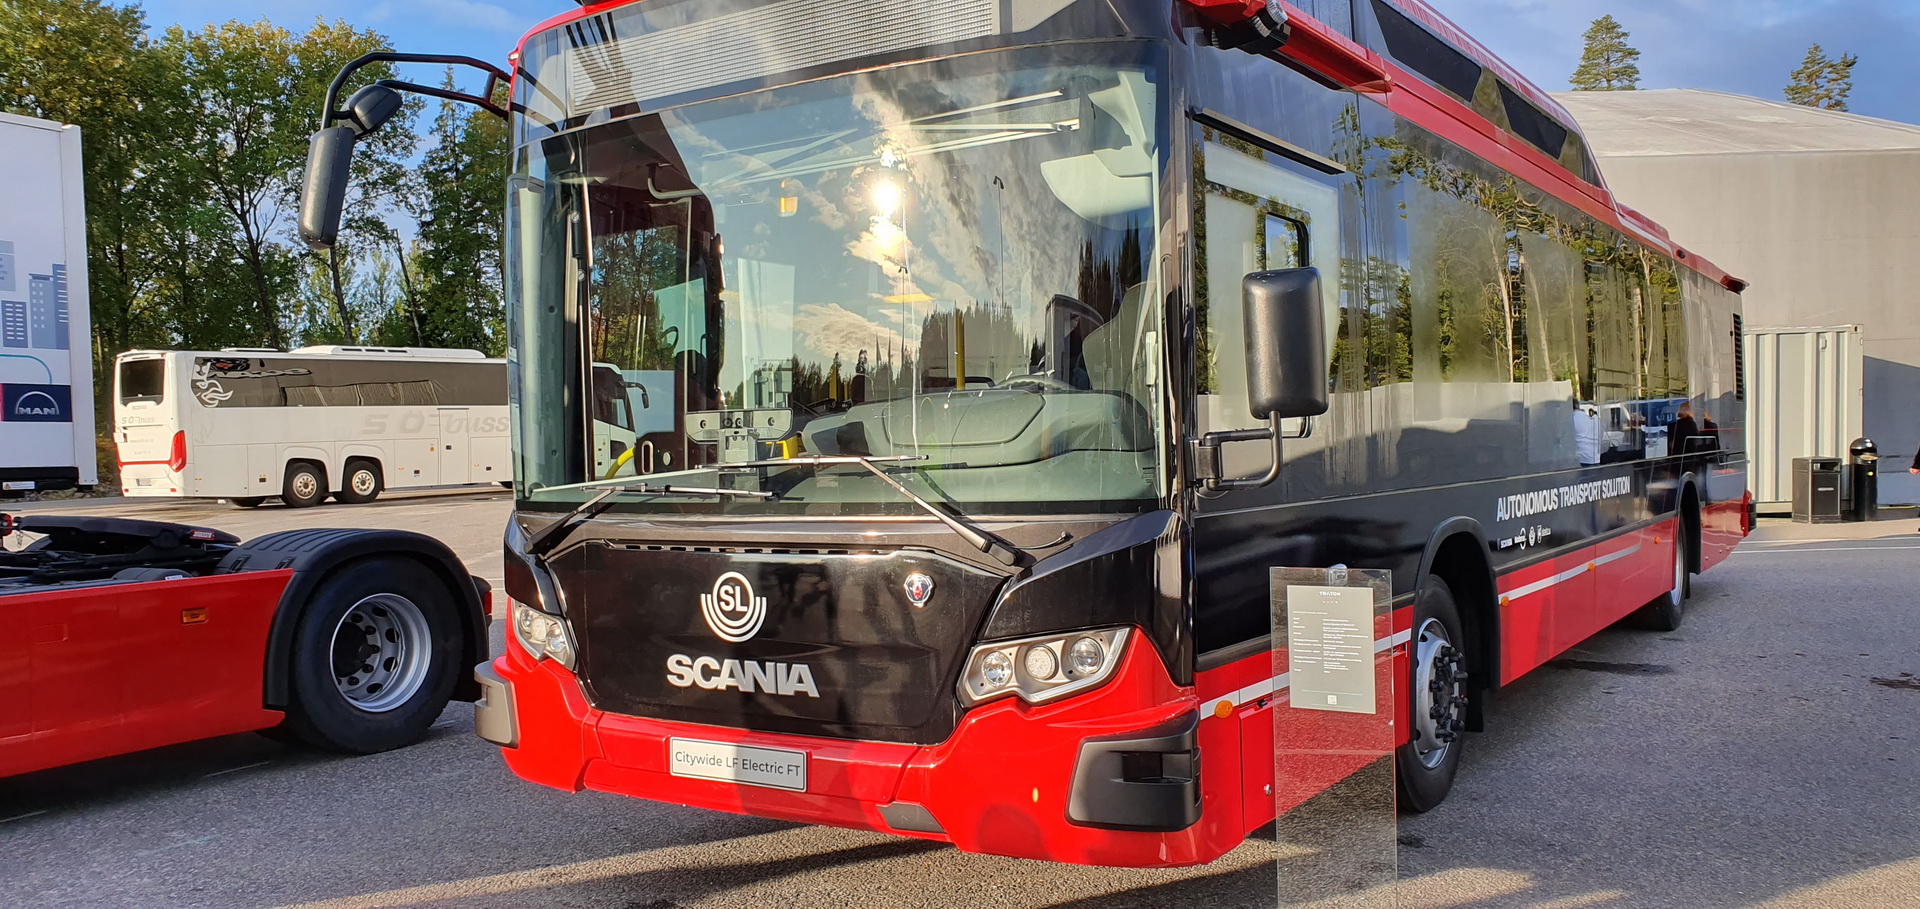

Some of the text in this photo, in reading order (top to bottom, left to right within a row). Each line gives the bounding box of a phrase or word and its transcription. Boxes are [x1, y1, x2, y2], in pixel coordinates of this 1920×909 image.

[19, 407, 56, 415] MAN
[1496, 476, 1630, 522] AUTONOMOUS TRANSPORT SOLUTION
[719, 584, 748, 612] SL
[666, 654, 820, 698] SCANIA
[675, 751, 800, 777] Citywide LF Electric FT
